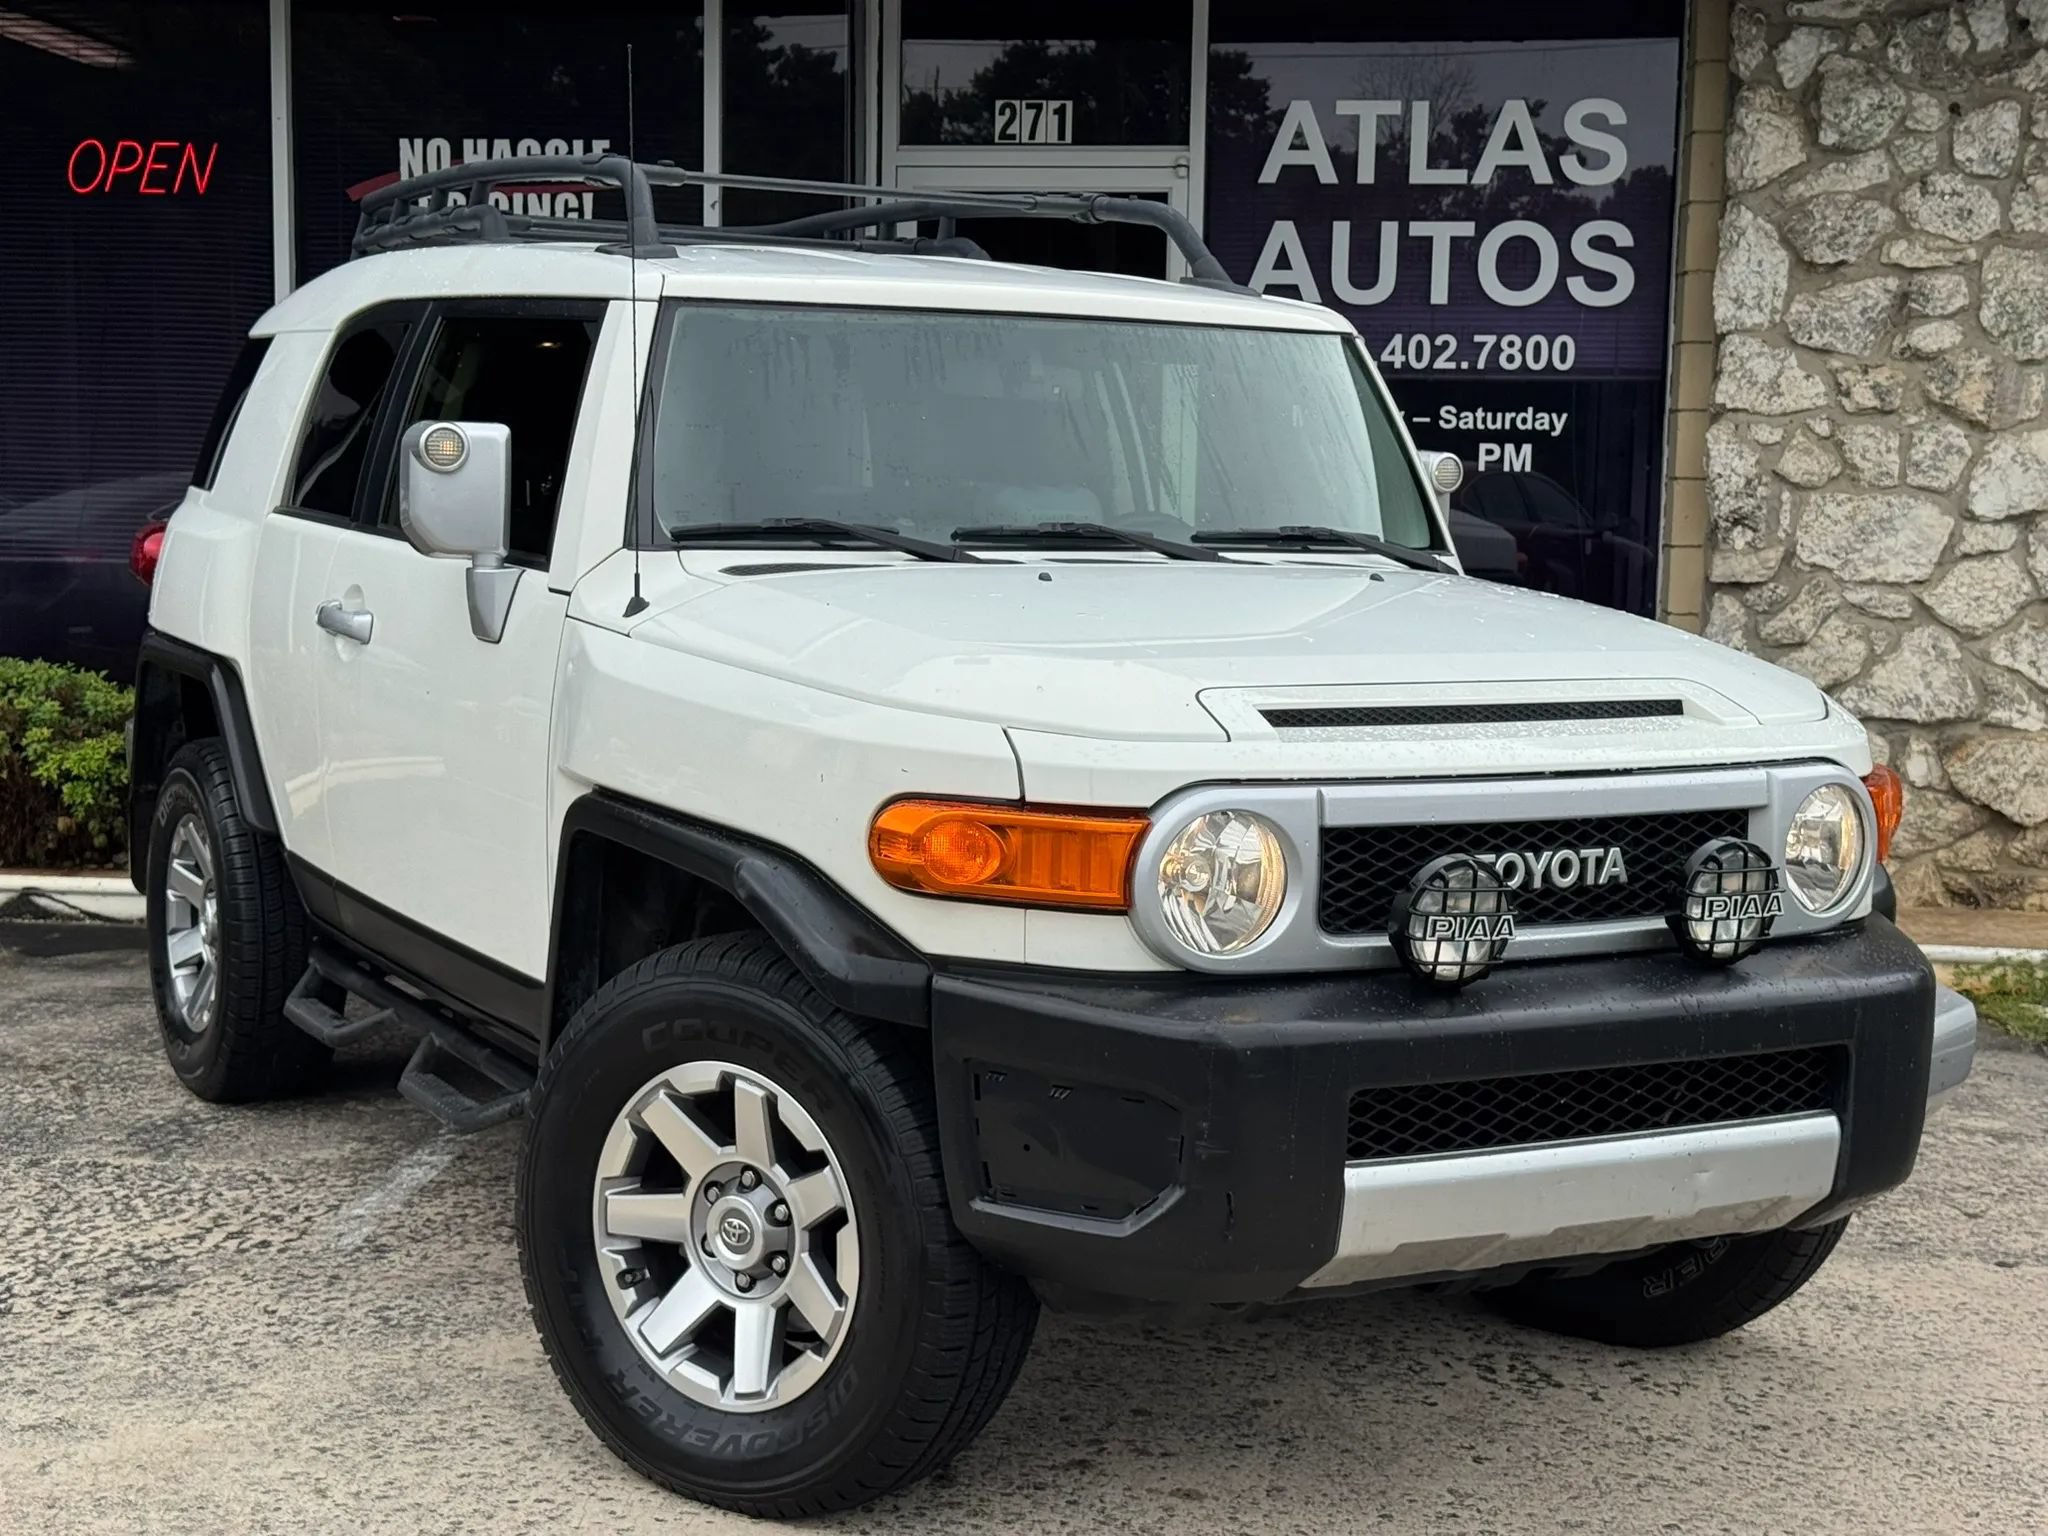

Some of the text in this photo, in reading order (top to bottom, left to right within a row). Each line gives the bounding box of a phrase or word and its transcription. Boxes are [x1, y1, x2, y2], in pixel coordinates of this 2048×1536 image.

[997, 101, 1067, 142] 271
[1257, 98, 1629, 186] ATLAS
[68, 138, 218, 194] OPEN
[398, 137, 451, 181] NO
[1247, 219, 1636, 307] AUTOS
[1438, 405, 1568, 437] Saturday
[1477, 442, 1533, 473] PM
[1704, 892, 1785, 921] PIAA
[1425, 914, 1518, 942] PIAA
